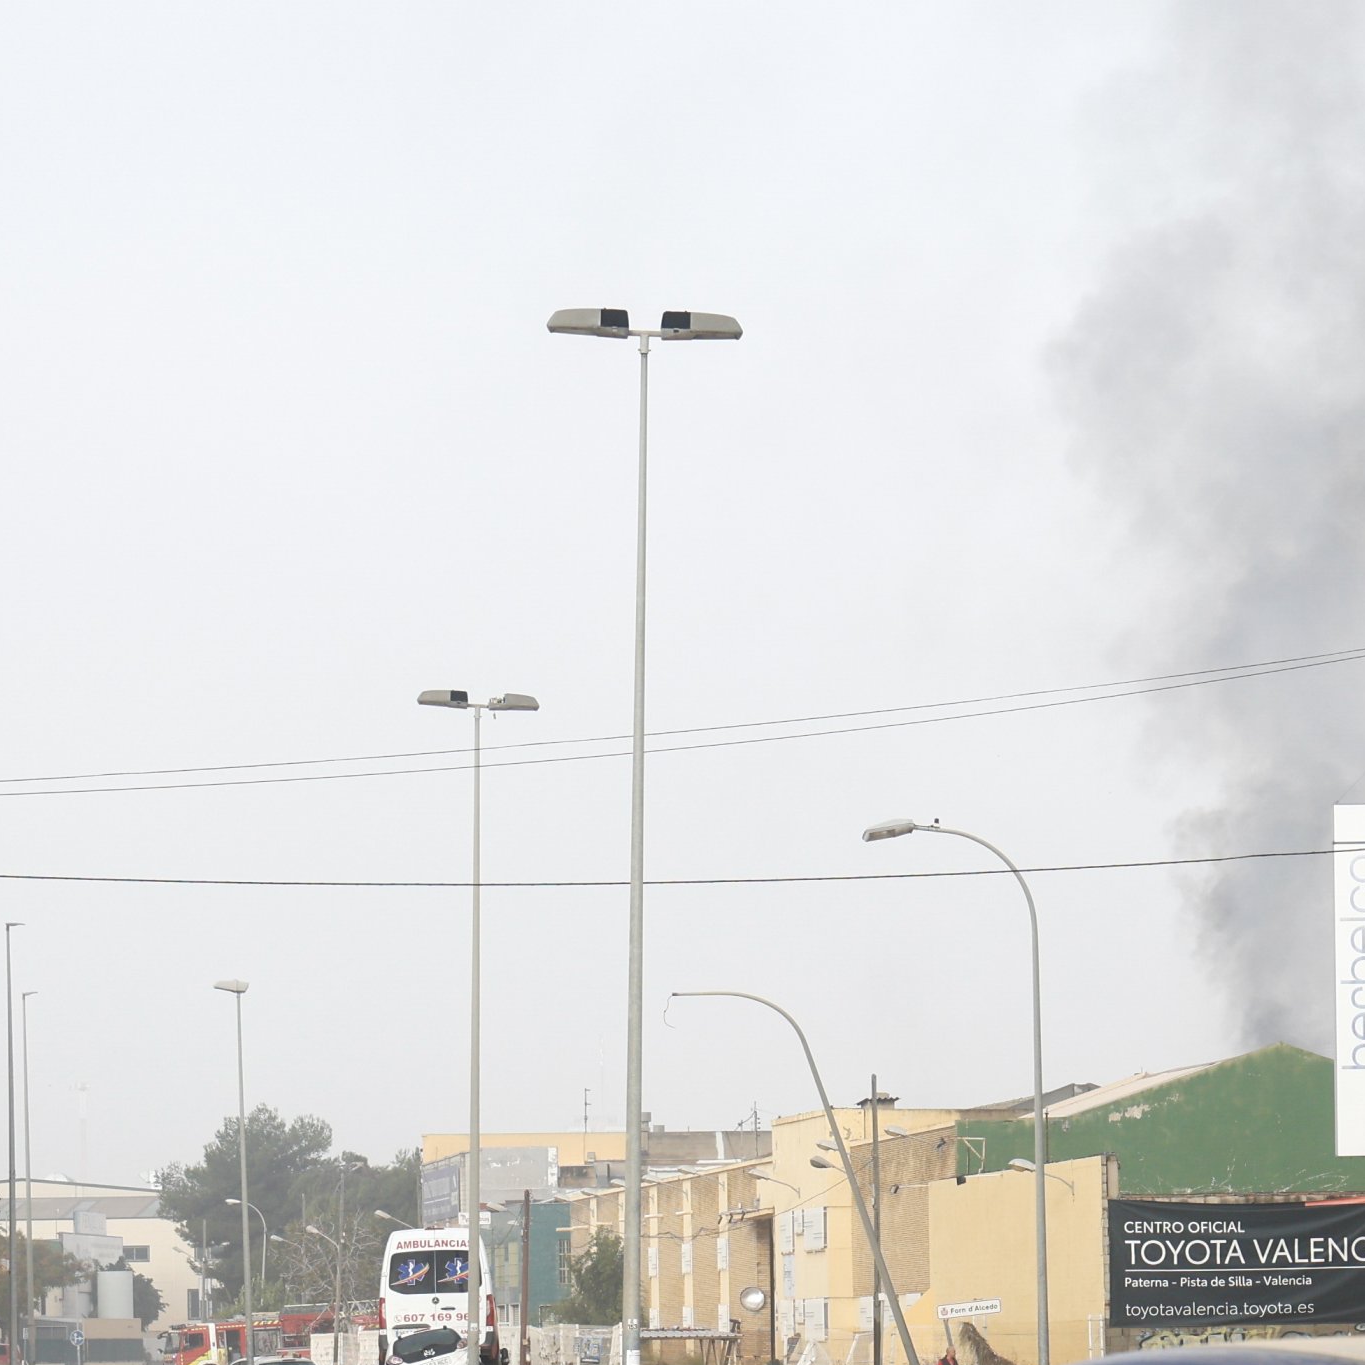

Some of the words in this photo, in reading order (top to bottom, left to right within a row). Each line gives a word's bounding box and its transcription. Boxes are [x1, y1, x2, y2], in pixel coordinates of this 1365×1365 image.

[1124, 1221, 1184, 1234] CENTRO
[1187, 1221, 1245, 1234] OFICIAL
[1124, 1239, 1246, 1265] TOYOTA
[1124, 1277, 1169, 1288] Paterna
[1180, 1277, 1208, 1287] Pista
[1210, 1277, 1225, 1287] de
[1228, 1276, 1253, 1287] Silla
[1263, 1275, 1312, 1286] Valencia
[403, 1313, 425, 1323] 607
[430, 1312, 452, 1322] 169
[1125, 1302, 1315, 1320] toyotavalencia.toyota.es
